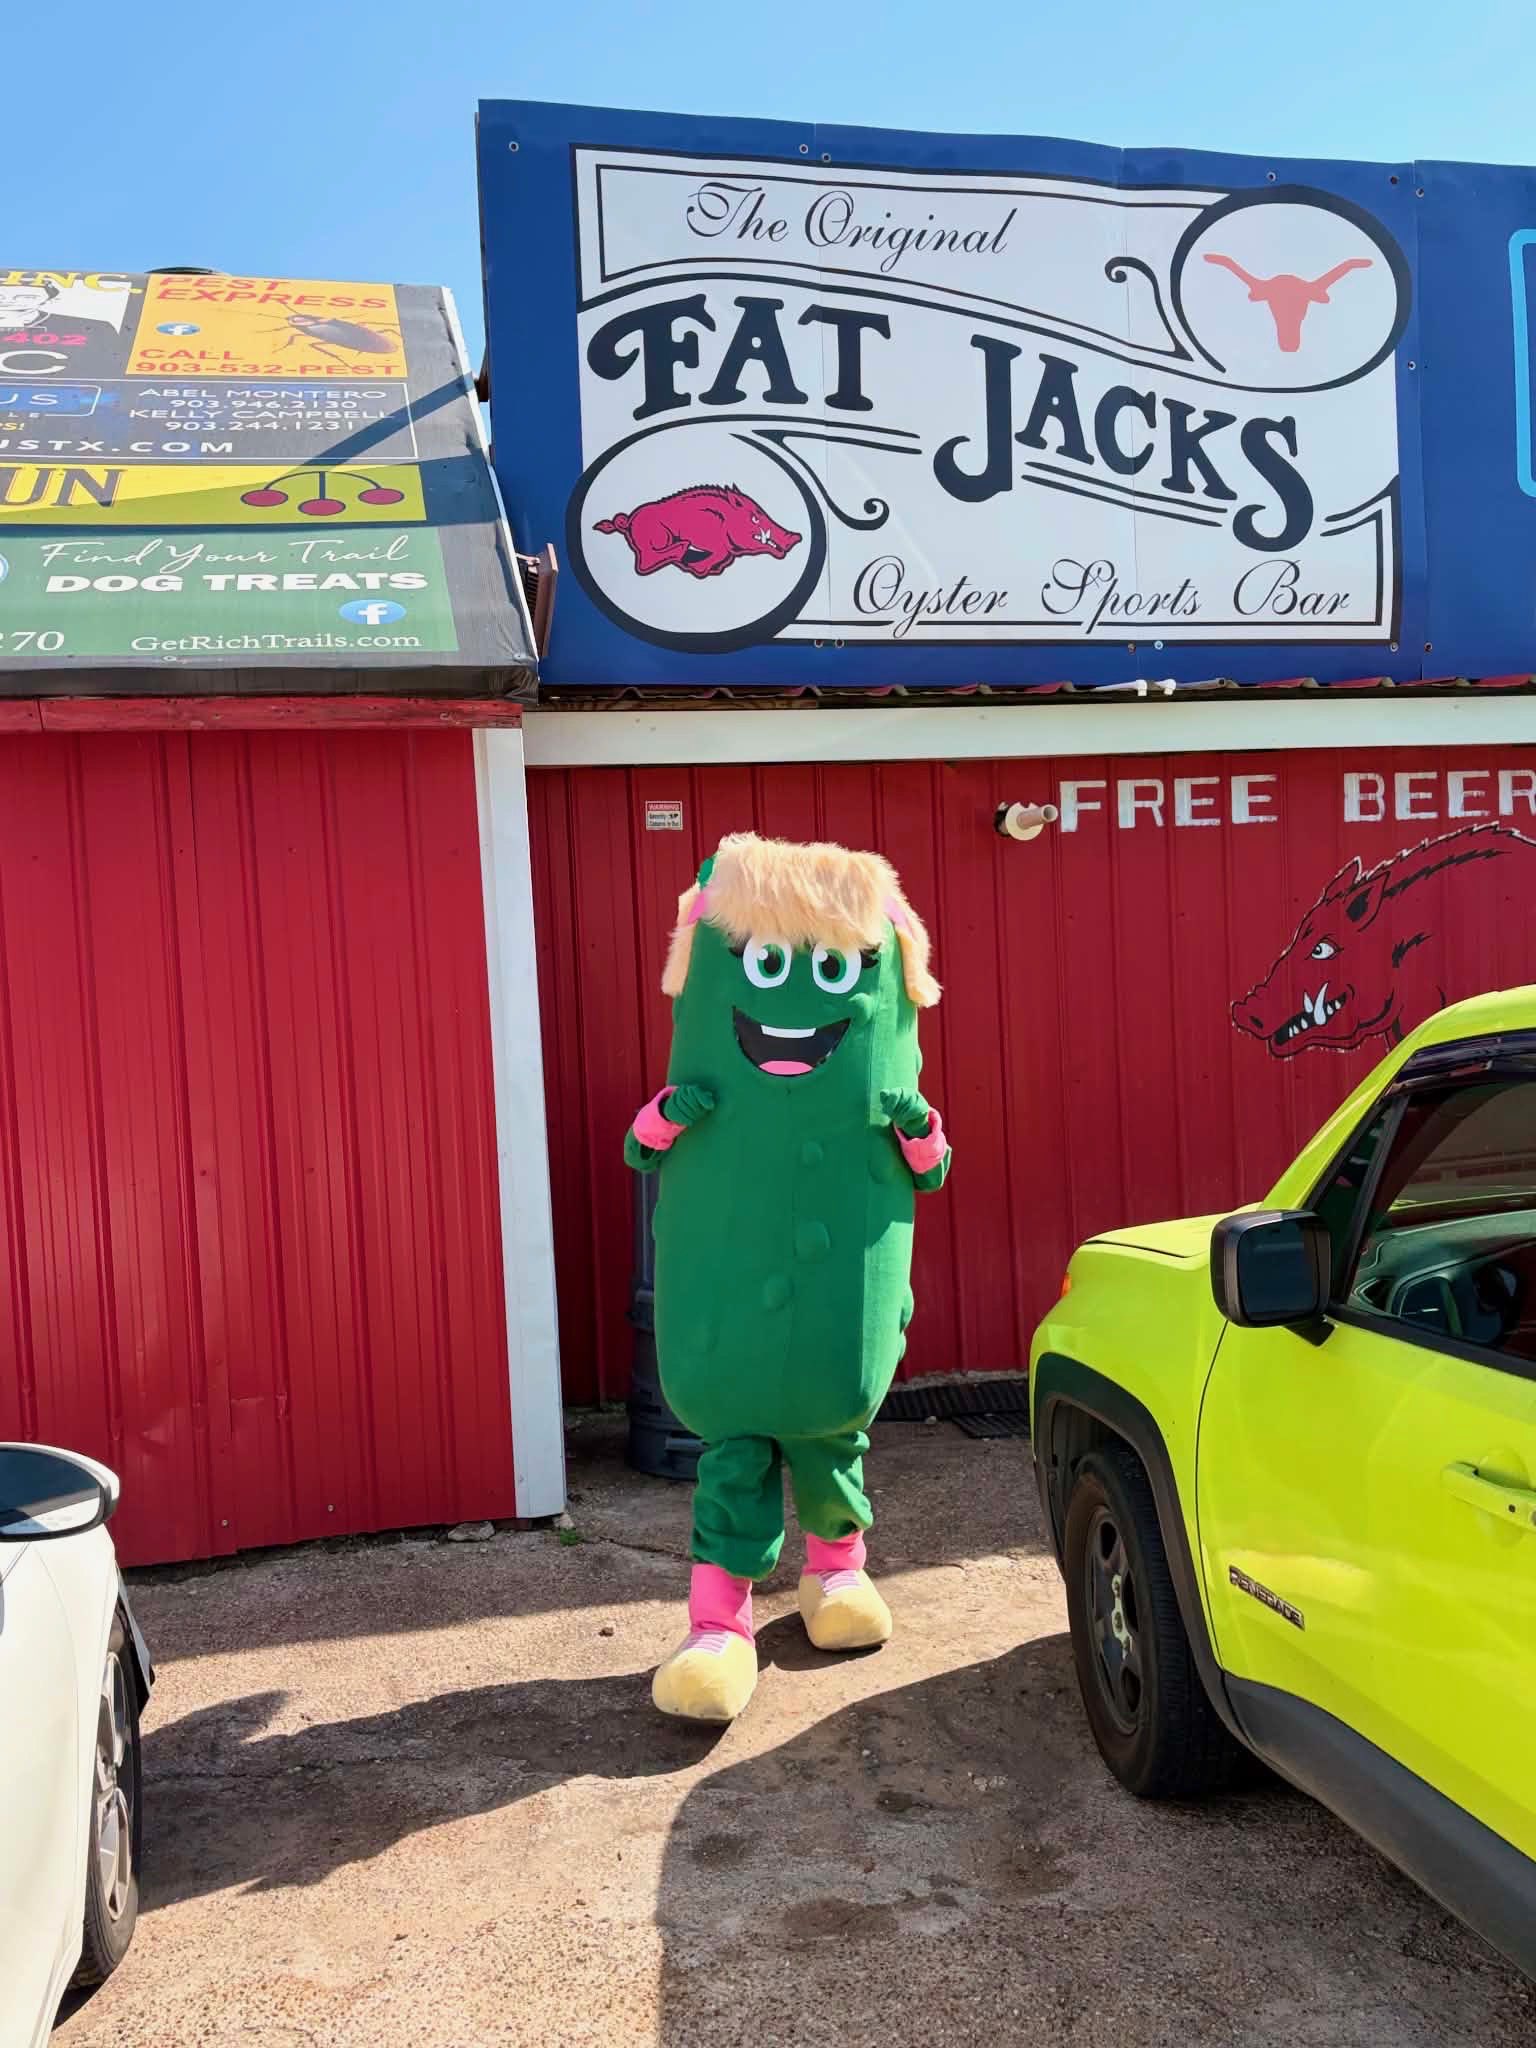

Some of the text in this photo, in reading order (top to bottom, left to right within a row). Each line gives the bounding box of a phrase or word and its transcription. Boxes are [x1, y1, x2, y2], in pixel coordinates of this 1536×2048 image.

[686, 181, 1018, 273] The Original
[159, 277, 290, 291] PEST
[156, 289, 387, 308] EXPRESS
[140, 349, 244, 360] CALL
[135, 362, 401, 375] 903-532-PEST
[138, 388, 387, 399] ABEL MONTERO
[170, 399, 357, 409] 903.946.2130
[129, 409, 394, 419] KELLY CAMPBELL
[586, 294, 1314, 552] FAT JACKS
[165, 421, 353, 431] 903.244.1231
[40, 535, 409, 575] Find Your Trail
[45, 572, 428, 593] DOG TREATS
[853, 555, 1351, 638] Oyster Sports Bar
[0, 631, 65, 651] 70
[130, 633, 421, 650] GetRichTrails.com
[1059, 769, 1536, 833] FREE BEER
